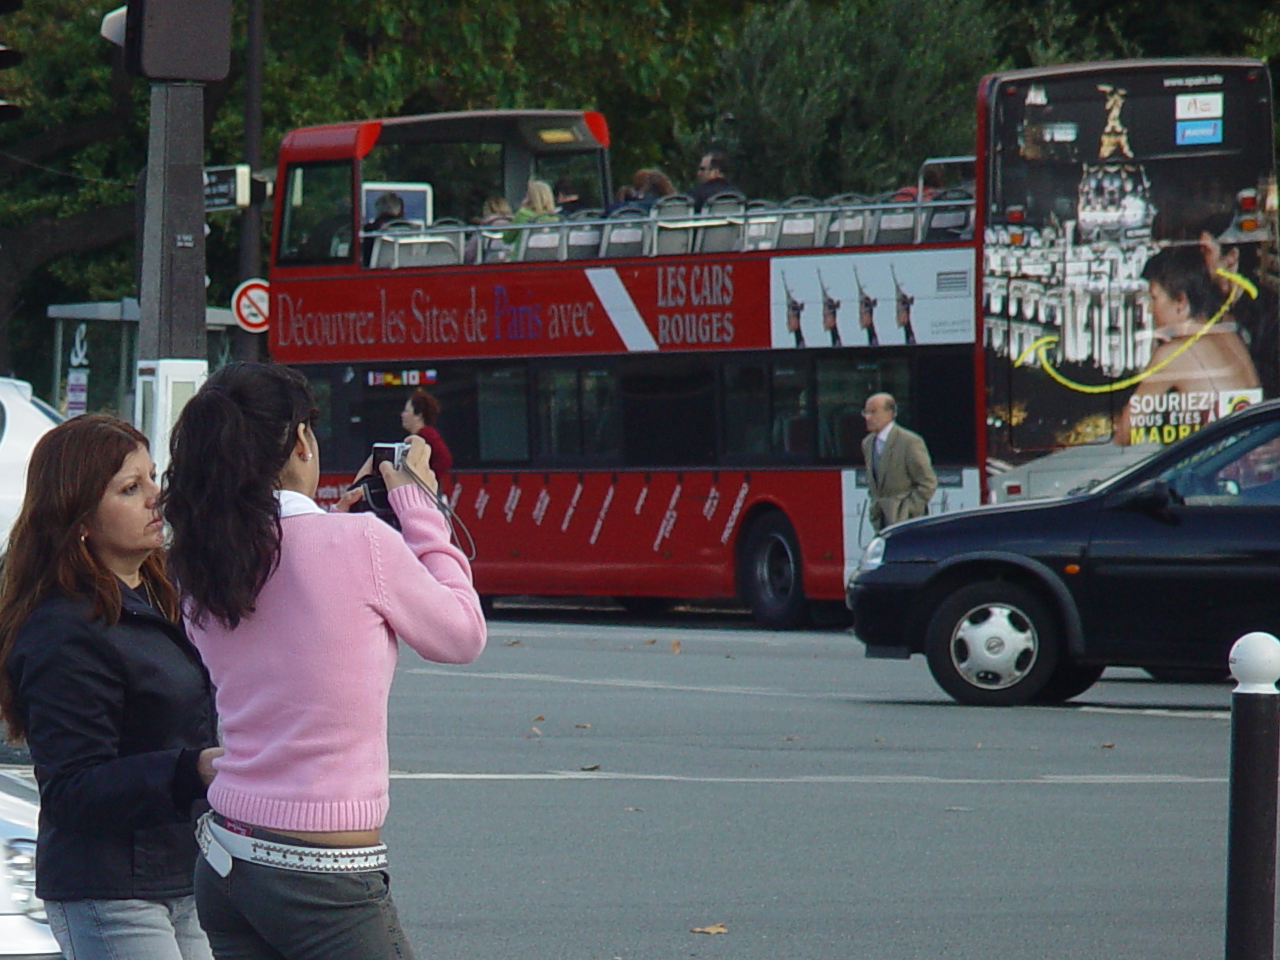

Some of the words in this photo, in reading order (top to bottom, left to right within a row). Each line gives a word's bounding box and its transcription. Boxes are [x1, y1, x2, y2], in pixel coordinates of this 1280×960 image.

[656, 266, 686, 308] LES
[690, 264, 734, 307] CARS
[277, 293, 374, 347] Découvrez
[380, 288, 406, 345] les
[410, 287, 459, 344] Sites
[464, 286, 487, 342] de
[493, 285, 542, 341] Paris
[548, 301, 595, 339] avec
[657, 312, 735, 344] ROUGES
[1129, 413, 1164, 427] VOUS
[1169, 410, 1202, 426] ÊTES
